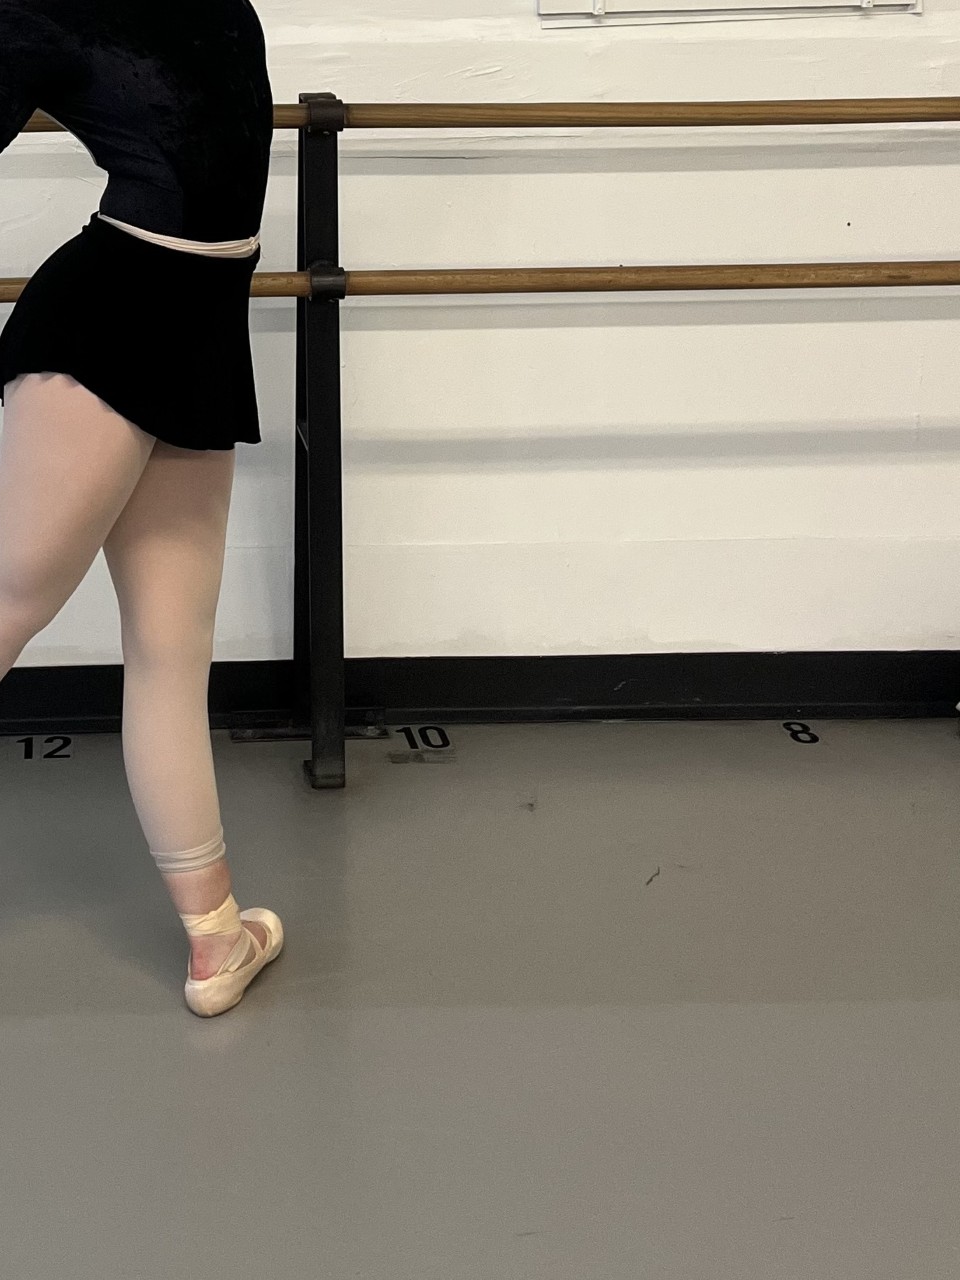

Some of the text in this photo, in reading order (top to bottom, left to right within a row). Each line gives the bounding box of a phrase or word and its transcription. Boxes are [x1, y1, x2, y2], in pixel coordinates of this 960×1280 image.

[395, 725, 451, 750] 10
[781, 721, 820, 745] 8
[15, 735, 72, 760] 12
